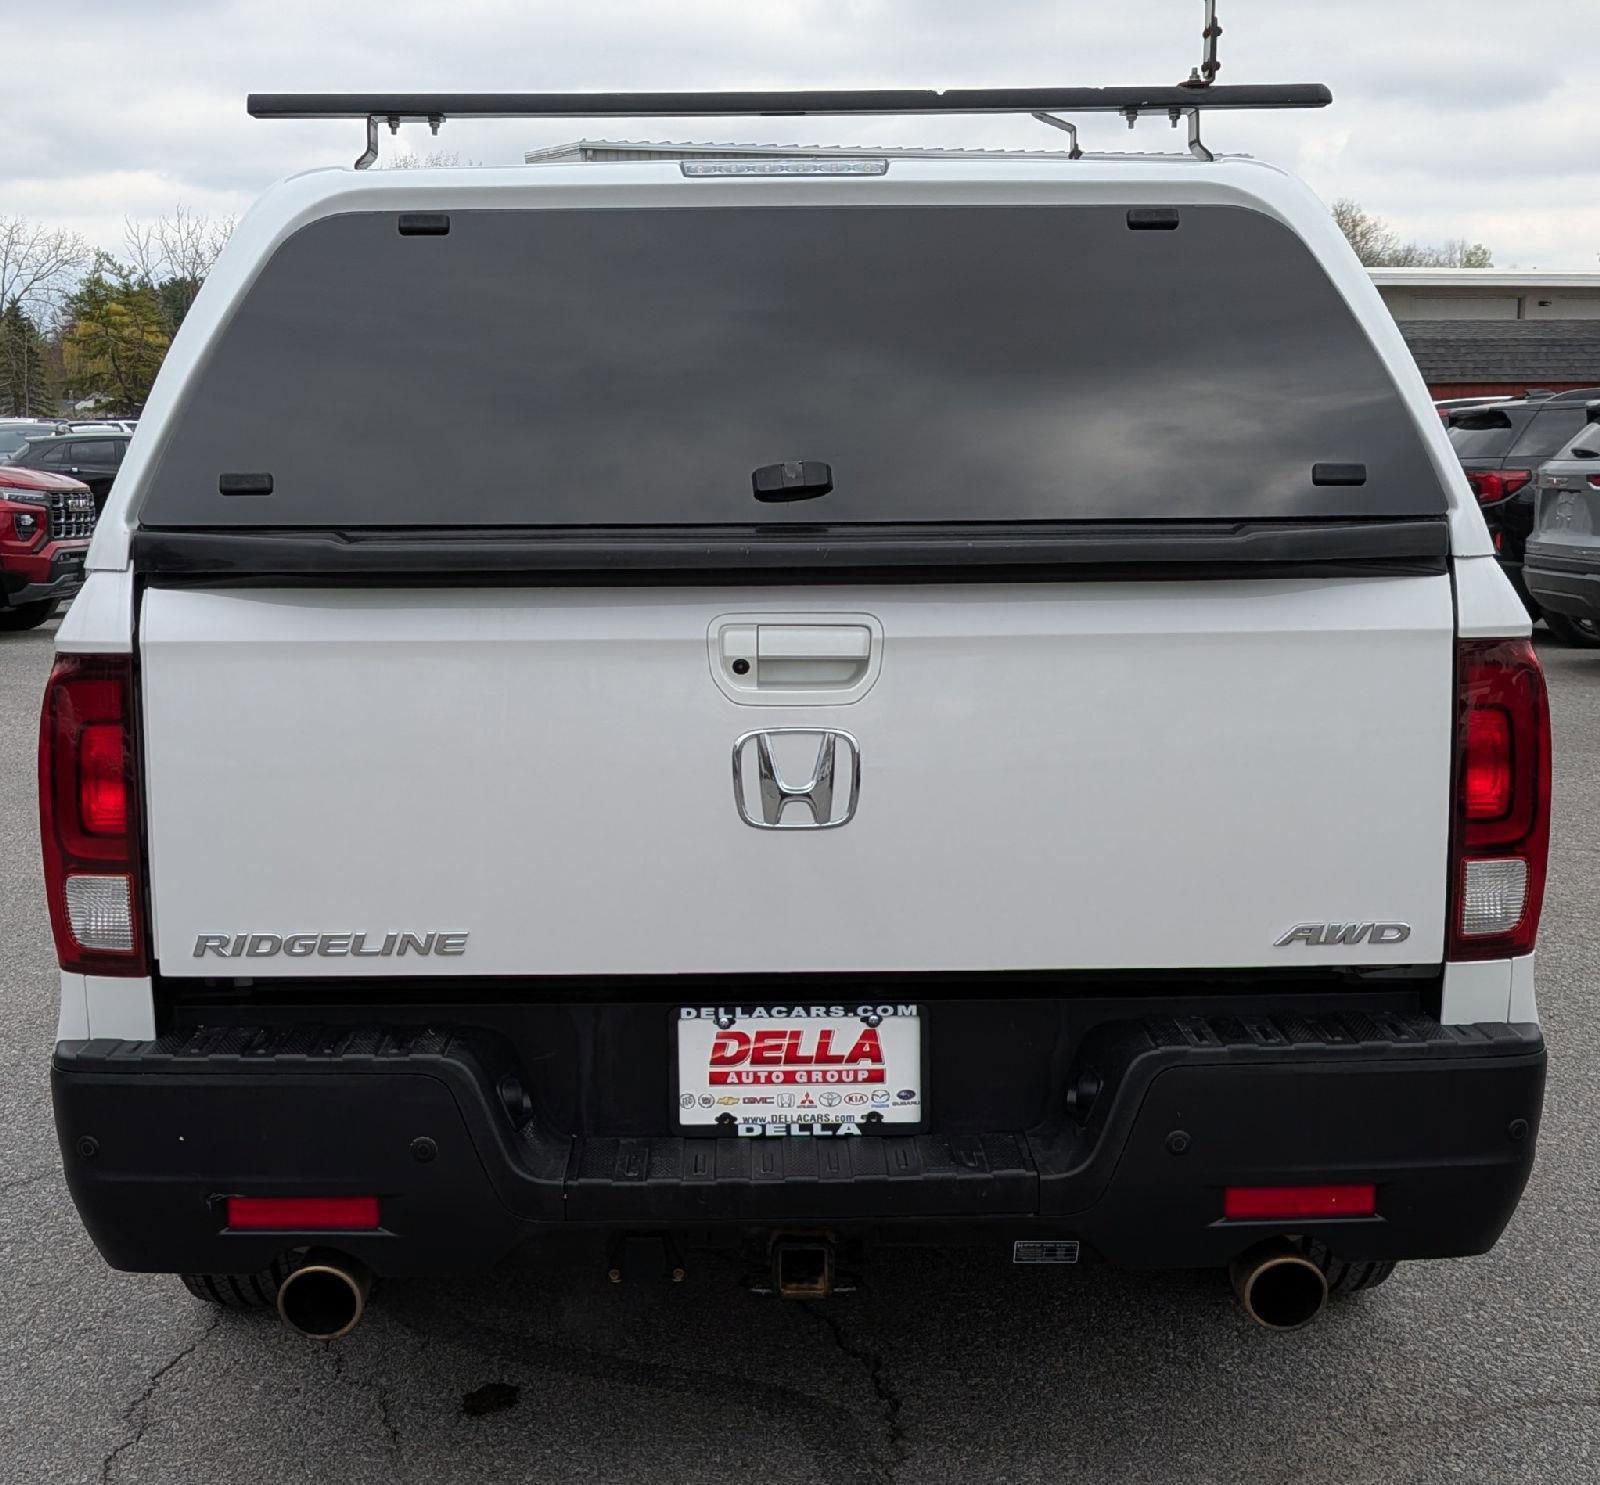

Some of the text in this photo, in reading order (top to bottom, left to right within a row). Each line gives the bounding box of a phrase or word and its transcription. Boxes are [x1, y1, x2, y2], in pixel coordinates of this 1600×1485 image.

[1273, 921, 1411, 946] AWD
[193, 931, 469, 957] RIDGELINE
[680, 1004, 918, 1019] DELLACARS.COM
[709, 1028, 886, 1066] DELLA
[726, 1070, 869, 1084] AUTO GROUP
[742, 1096, 775, 1105] GMC
[742, 1114, 855, 1124] www.DELLACARS.com
[737, 1123, 862, 1136] DELLA
